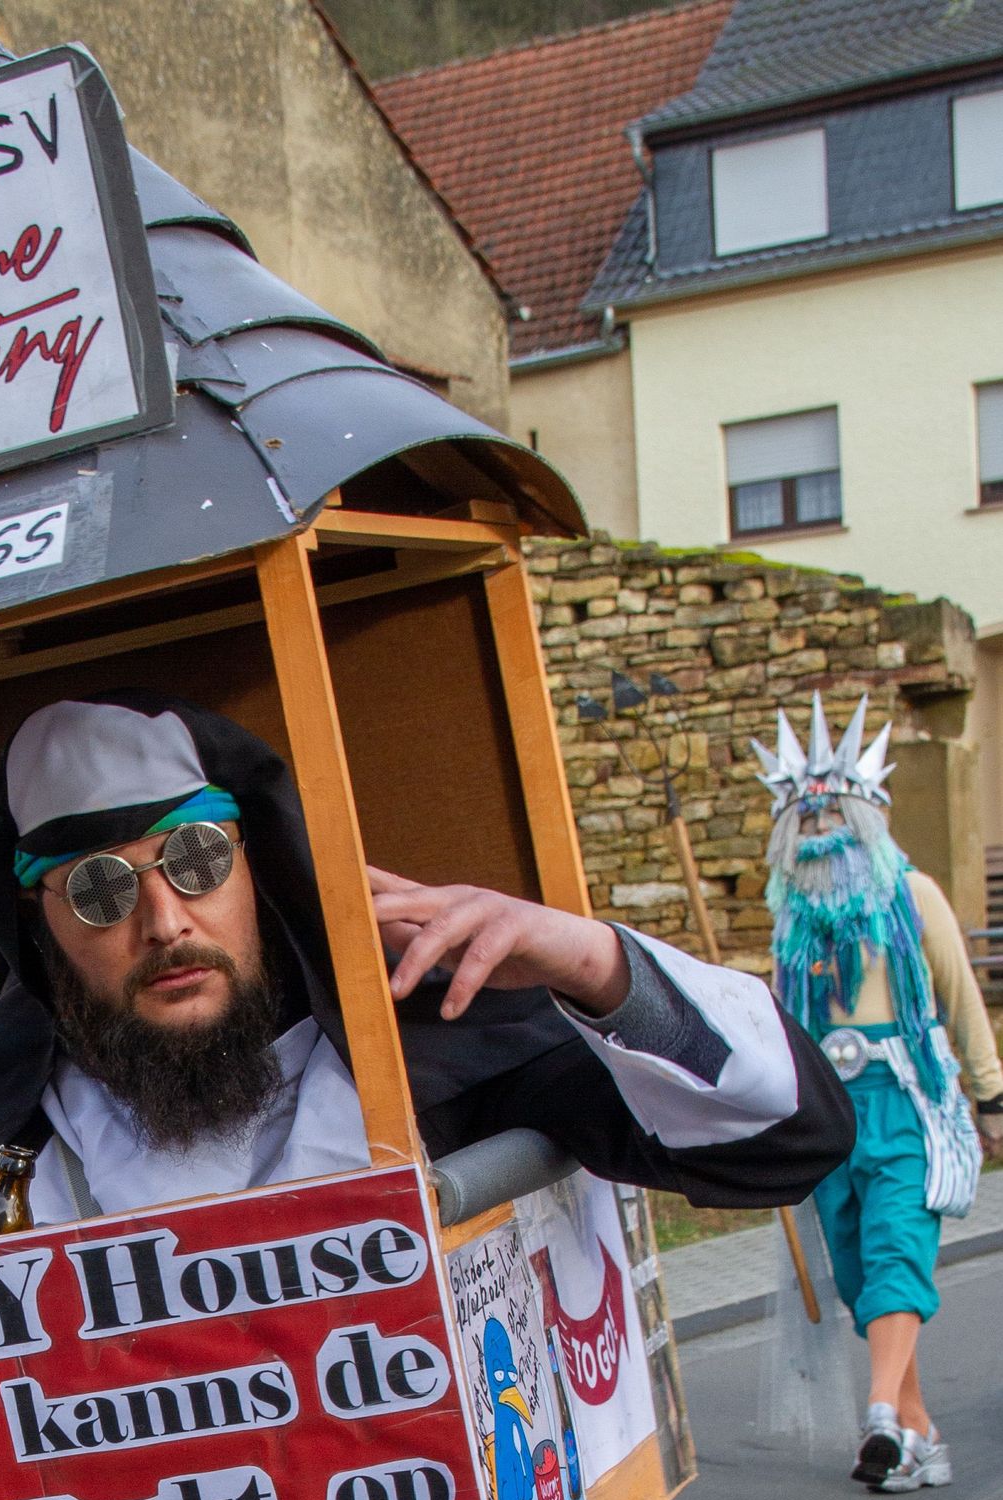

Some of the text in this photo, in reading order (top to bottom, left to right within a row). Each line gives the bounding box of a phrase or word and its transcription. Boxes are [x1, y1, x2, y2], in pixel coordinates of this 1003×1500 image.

[70, 1220, 420, 1335] House
[3, 1368, 293, 1460] kanns
[324, 1331, 440, 1410] de
[571, 1295, 619, 1389] TO GO!
